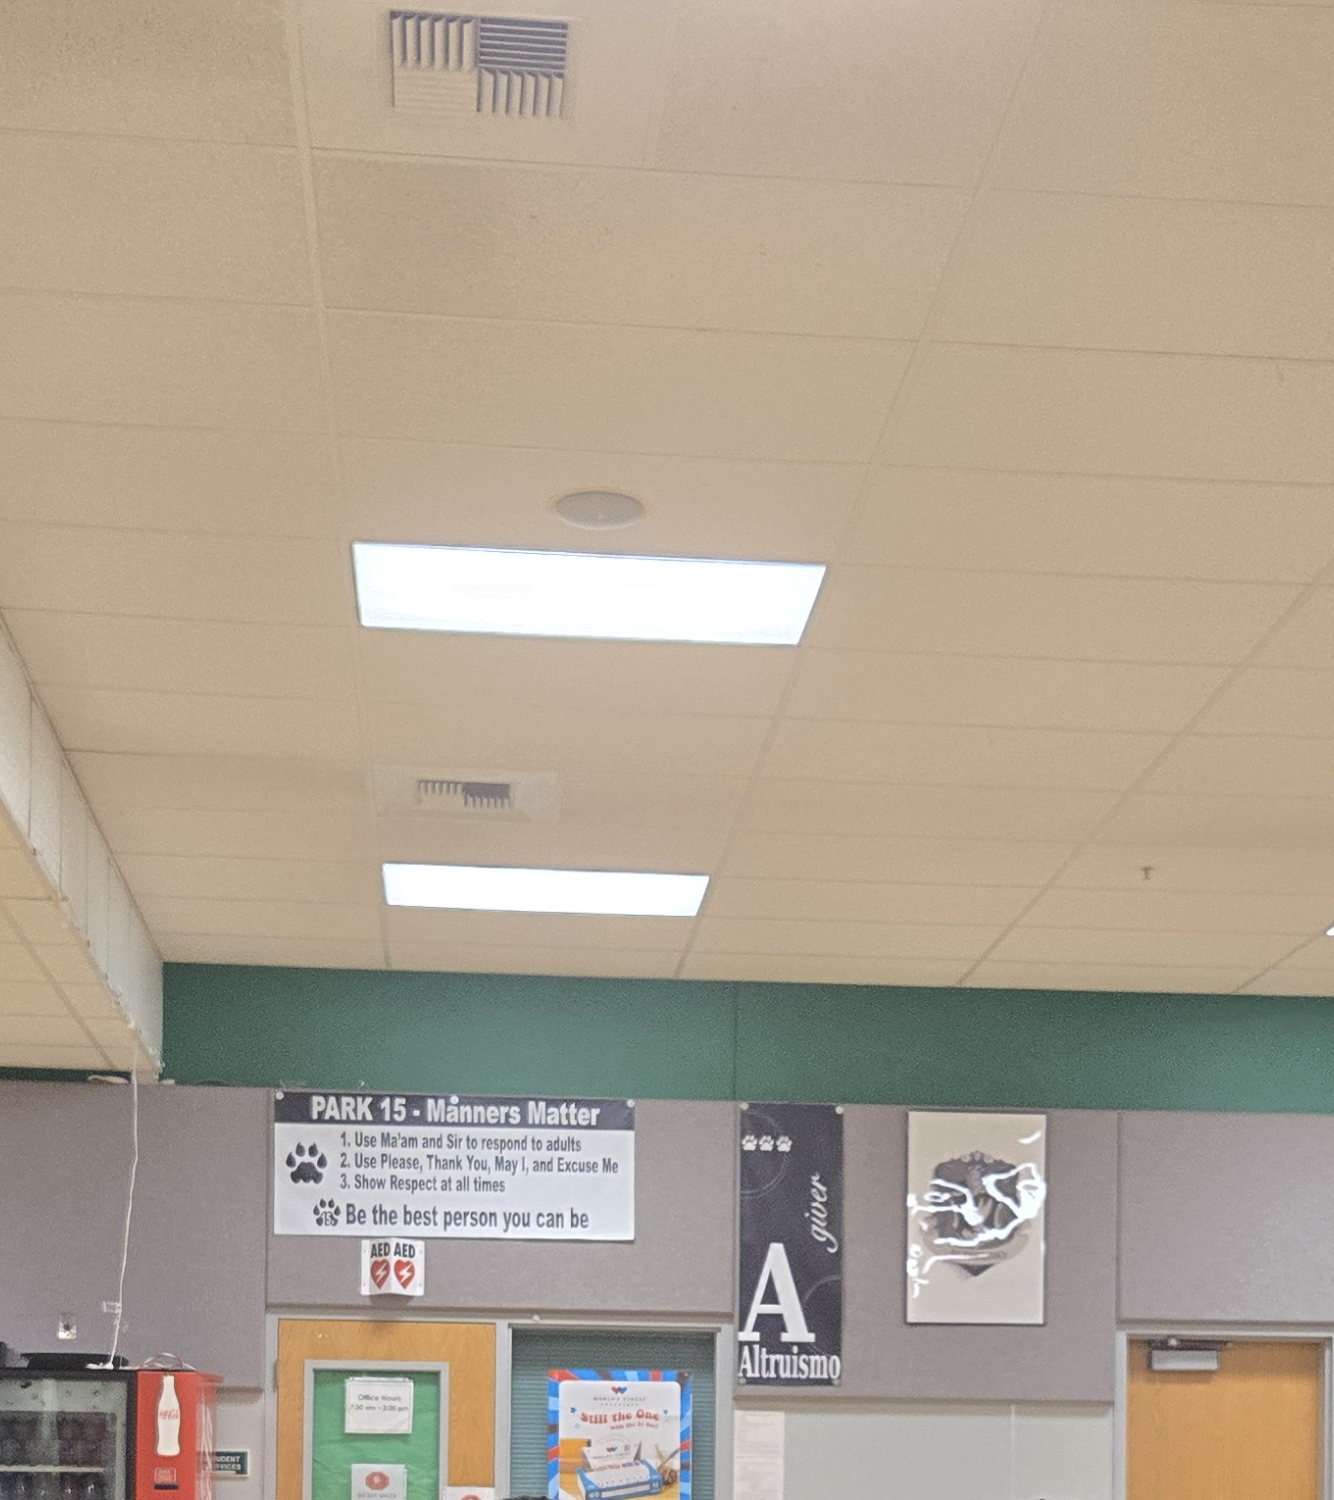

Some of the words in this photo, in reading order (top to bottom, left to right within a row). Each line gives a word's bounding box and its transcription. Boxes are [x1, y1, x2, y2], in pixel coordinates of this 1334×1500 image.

[310, 1095, 373, 1122] PARK
[379, 1098, 408, 1122] 15
[426, 1099, 521, 1125] Manners
[527, 1101, 601, 1127] Matter
[340, 1131, 352, 1148] 1.
[354, 1132, 379, 1149] Use
[380, 1132, 419, 1150] Ma'am
[421, 1132, 443, 1150] and
[446, 1133, 464, 1150] Sir
[465, 1135, 479, 1151] to
[480, 1134, 529, 1153] respond
[530, 1136, 544, 1152] to
[545, 1135, 583, 1153] adults
[339, 1152, 352, 1169] 2.
[354, 1153, 378, 1170] Use
[380, 1153, 424, 1173] Please,
[426, 1154, 464, 1171] Thank
[465, 1154, 492, 1175] You,
[493, 1155, 519, 1175] May
[531, 1156, 555, 1173] and
[556, 1156, 600, 1174] Excuse
[601, 1157, 619, 1174] Me
[339, 1173, 352, 1190] 3.
[353, 1174, 387, 1191] Show
[389, 1174, 438, 1194] Respect
[439, 1176, 454, 1192] at
[455, 1175, 471, 1192] all
[472, 1176, 506, 1193] times
[345, 1202, 367, 1226] Be
[371, 1203, 398, 1227] the
[402, 1204, 439, 1228] best
[443, 1208, 498, 1232] person
[502, 1211, 531, 1234] you
[535, 1211, 565, 1229] can
[569, 1207, 590, 1229] be
[804, 1170, 839, 1253] giver
[369, 1242, 391, 1259] AED
[393, 1243, 416, 1259] AED
[737, 1241, 816, 1343] A
[738, 1344, 842, 1380] Altruismo
[357, 1394, 380, 1402] Office
[381, 1394, 402, 1402] Hours
[580, 1411, 609, 1424] Still
[611, 1411, 633, 1423] the
[635, 1408, 660, 1421] One
